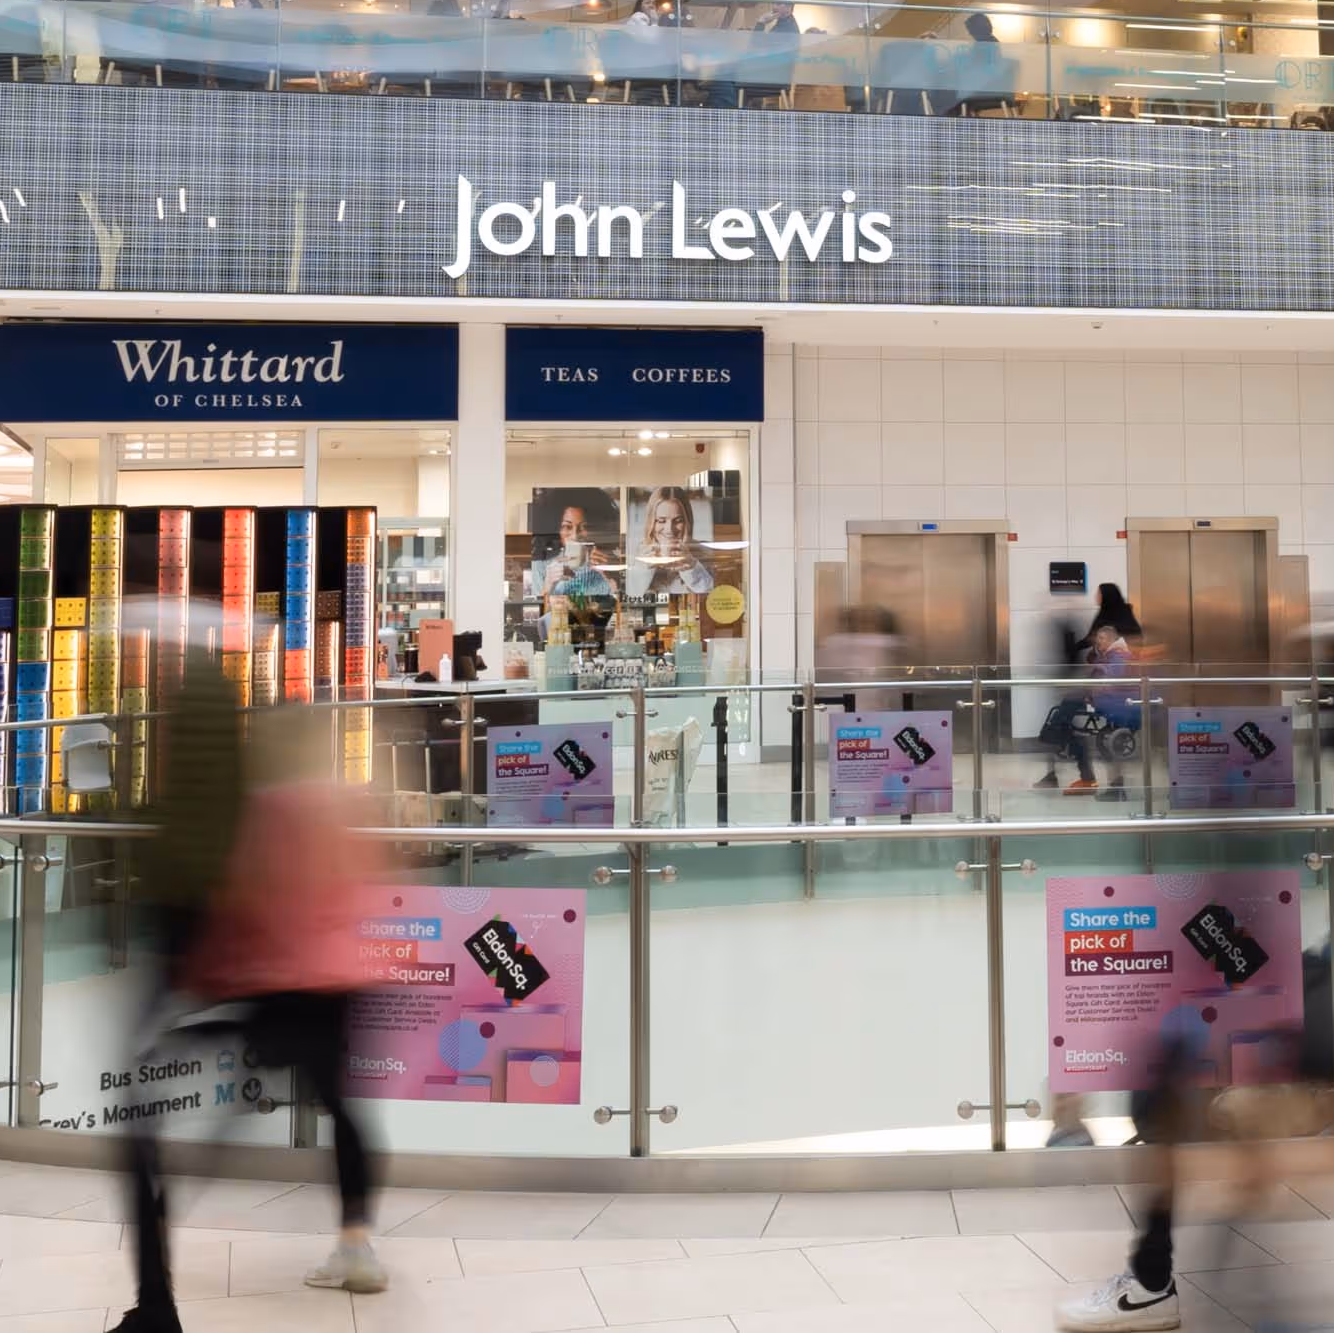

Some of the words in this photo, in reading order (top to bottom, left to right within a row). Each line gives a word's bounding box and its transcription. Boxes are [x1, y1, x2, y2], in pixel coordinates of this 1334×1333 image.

[441, 173, 643, 279] John
[671, 179, 893, 263] Lewis
[111, 339, 345, 383] Whittard
[541, 367, 599, 382] TEAS
[631, 368, 732, 384] COFFEES
[154, 394, 183, 408] OF
[195, 394, 303, 408] CHELSEA
[839, 740, 857, 749] pick
[858, 739, 868, 748] of
[498, 756, 516, 766] pick
[517, 755, 527, 764] of
[839, 750, 854, 760] the
[855, 750, 888, 760] Square!
[498, 768, 512, 777] the
[514, 766, 547, 777] Square!
[1069, 911, 1119, 928] Share
[1123, 911, 1151, 926] the
[360, 921, 407, 938] Share
[410, 920, 436, 937] the
[359, 943, 391, 961] pick
[395, 943, 413, 959] of
[1070, 934, 1105, 953] pick
[1109, 933, 1128, 949] of
[1198, 913, 1249, 974] EldonSq.
[481, 927, 529, 991] EldonSq.
[1070, 957, 1099, 973] the
[1103, 954, 1168, 974] Square!
[388, 965, 450, 985] Square!
[1078, 1007, 1110, 1015] Customer
[349, 1055, 407, 1074] EldonSq.
[1065, 1048, 1128, 1064] EldonSq.
[100, 1071, 132, 1091] Bus
[138, 1058, 202, 1084] Station
[104, 1091, 202, 1125] Monument
